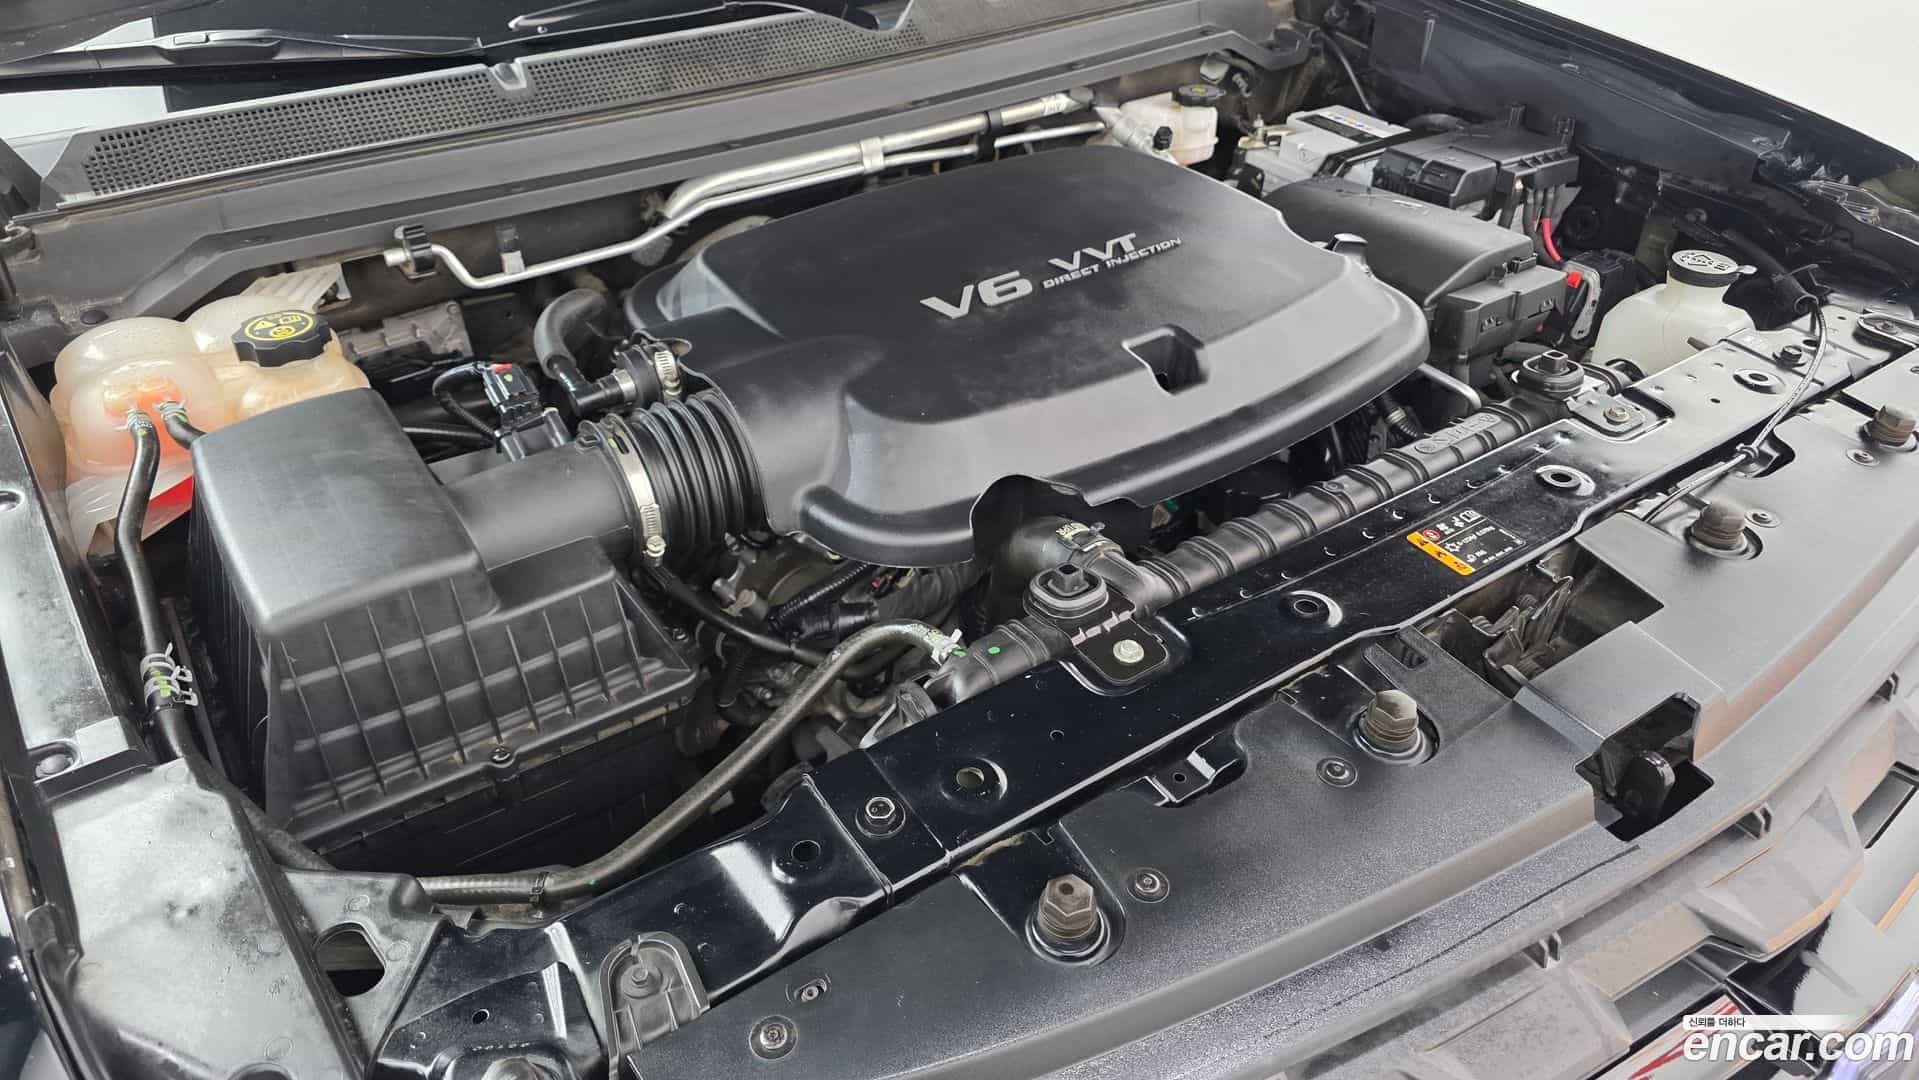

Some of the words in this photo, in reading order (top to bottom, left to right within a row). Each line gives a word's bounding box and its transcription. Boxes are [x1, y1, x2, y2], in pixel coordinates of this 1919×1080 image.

[919, 270, 1033, 319] V6
[1048, 232, 1136, 271] VVT
[1042, 263, 1100, 289] DIRECT
[1105, 237, 1181, 269] INJECTION
